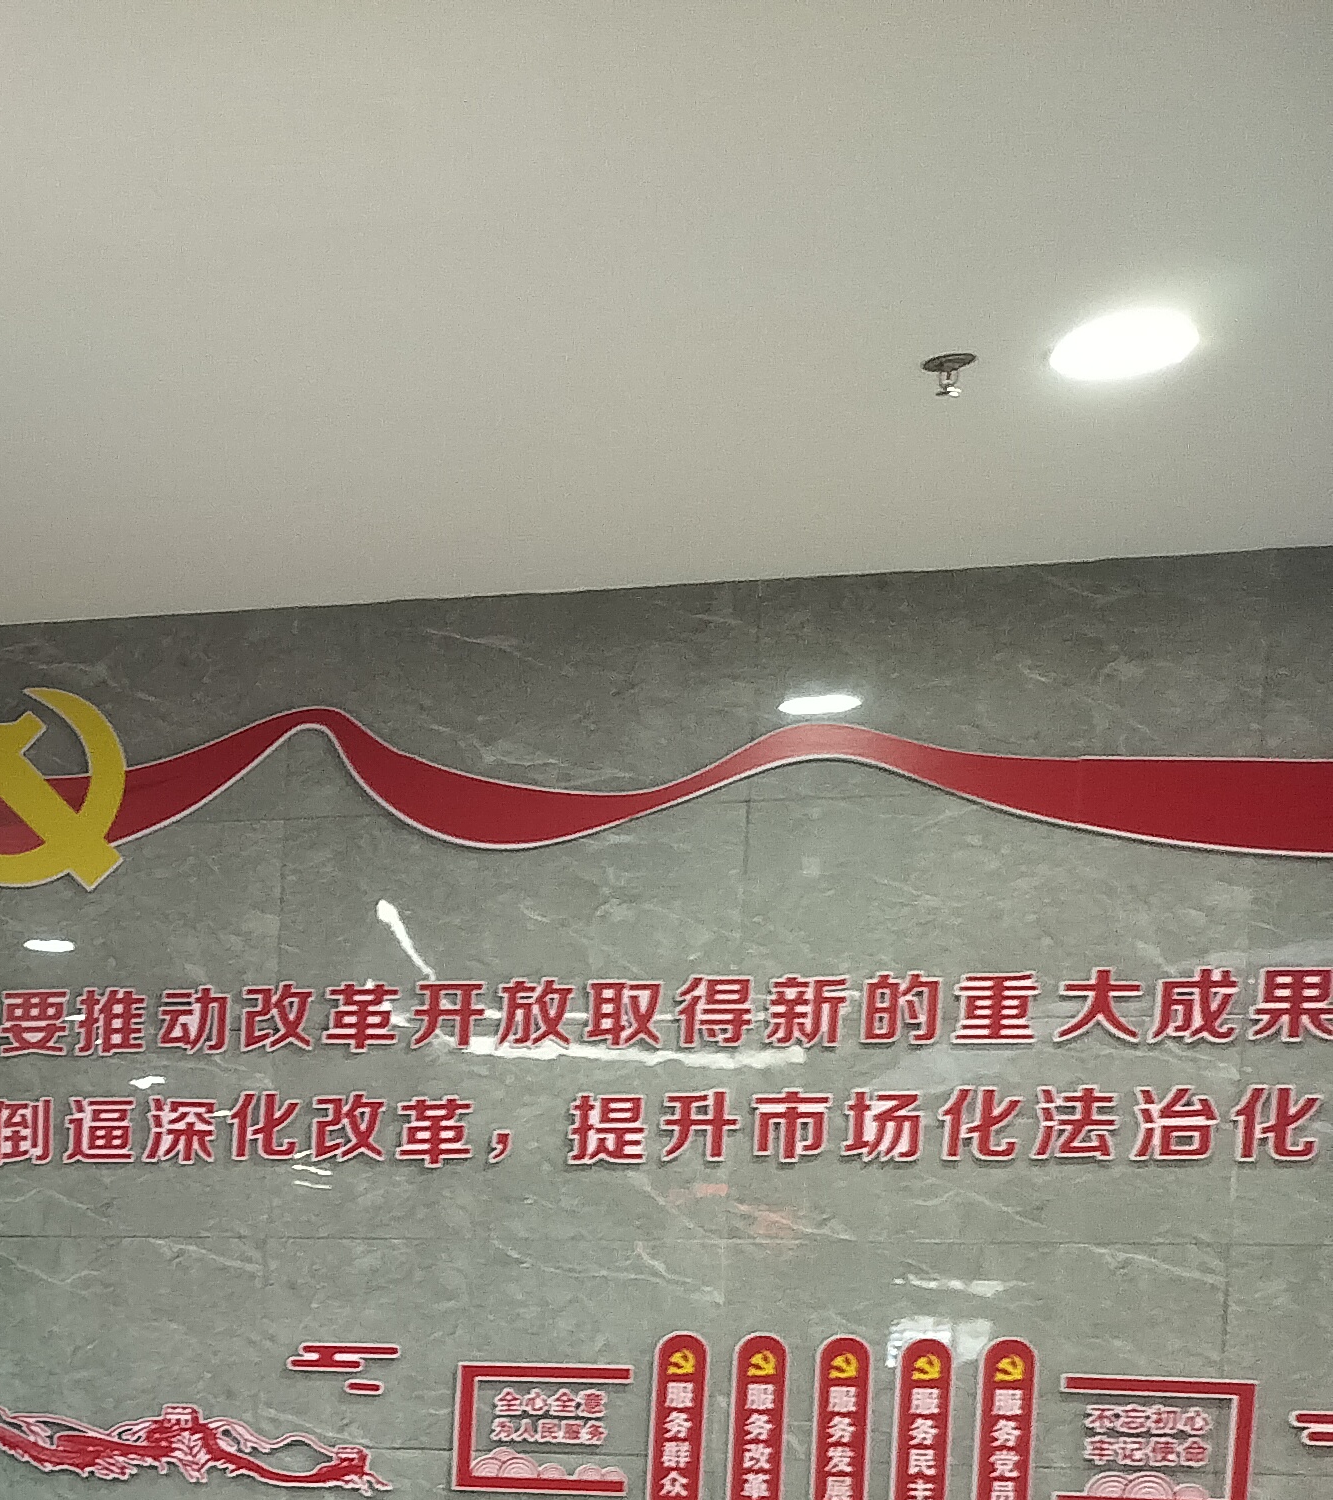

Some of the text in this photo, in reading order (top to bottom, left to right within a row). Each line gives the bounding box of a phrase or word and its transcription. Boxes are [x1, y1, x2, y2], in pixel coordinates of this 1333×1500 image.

[0, 967, 1333, 1057] 要推动改革开放取得新的重大成果
[494, 1388, 607, 1418] 全心全意
[490, 1418, 608, 1445] 为人民服务
[1084, 1404, 1213, 1435] 不忘初心
[658, 1381, 695, 1498] 服务群众
[739, 1383, 776, 1500] 服务改革
[1084, 1435, 1212, 1467] 牢记使命
